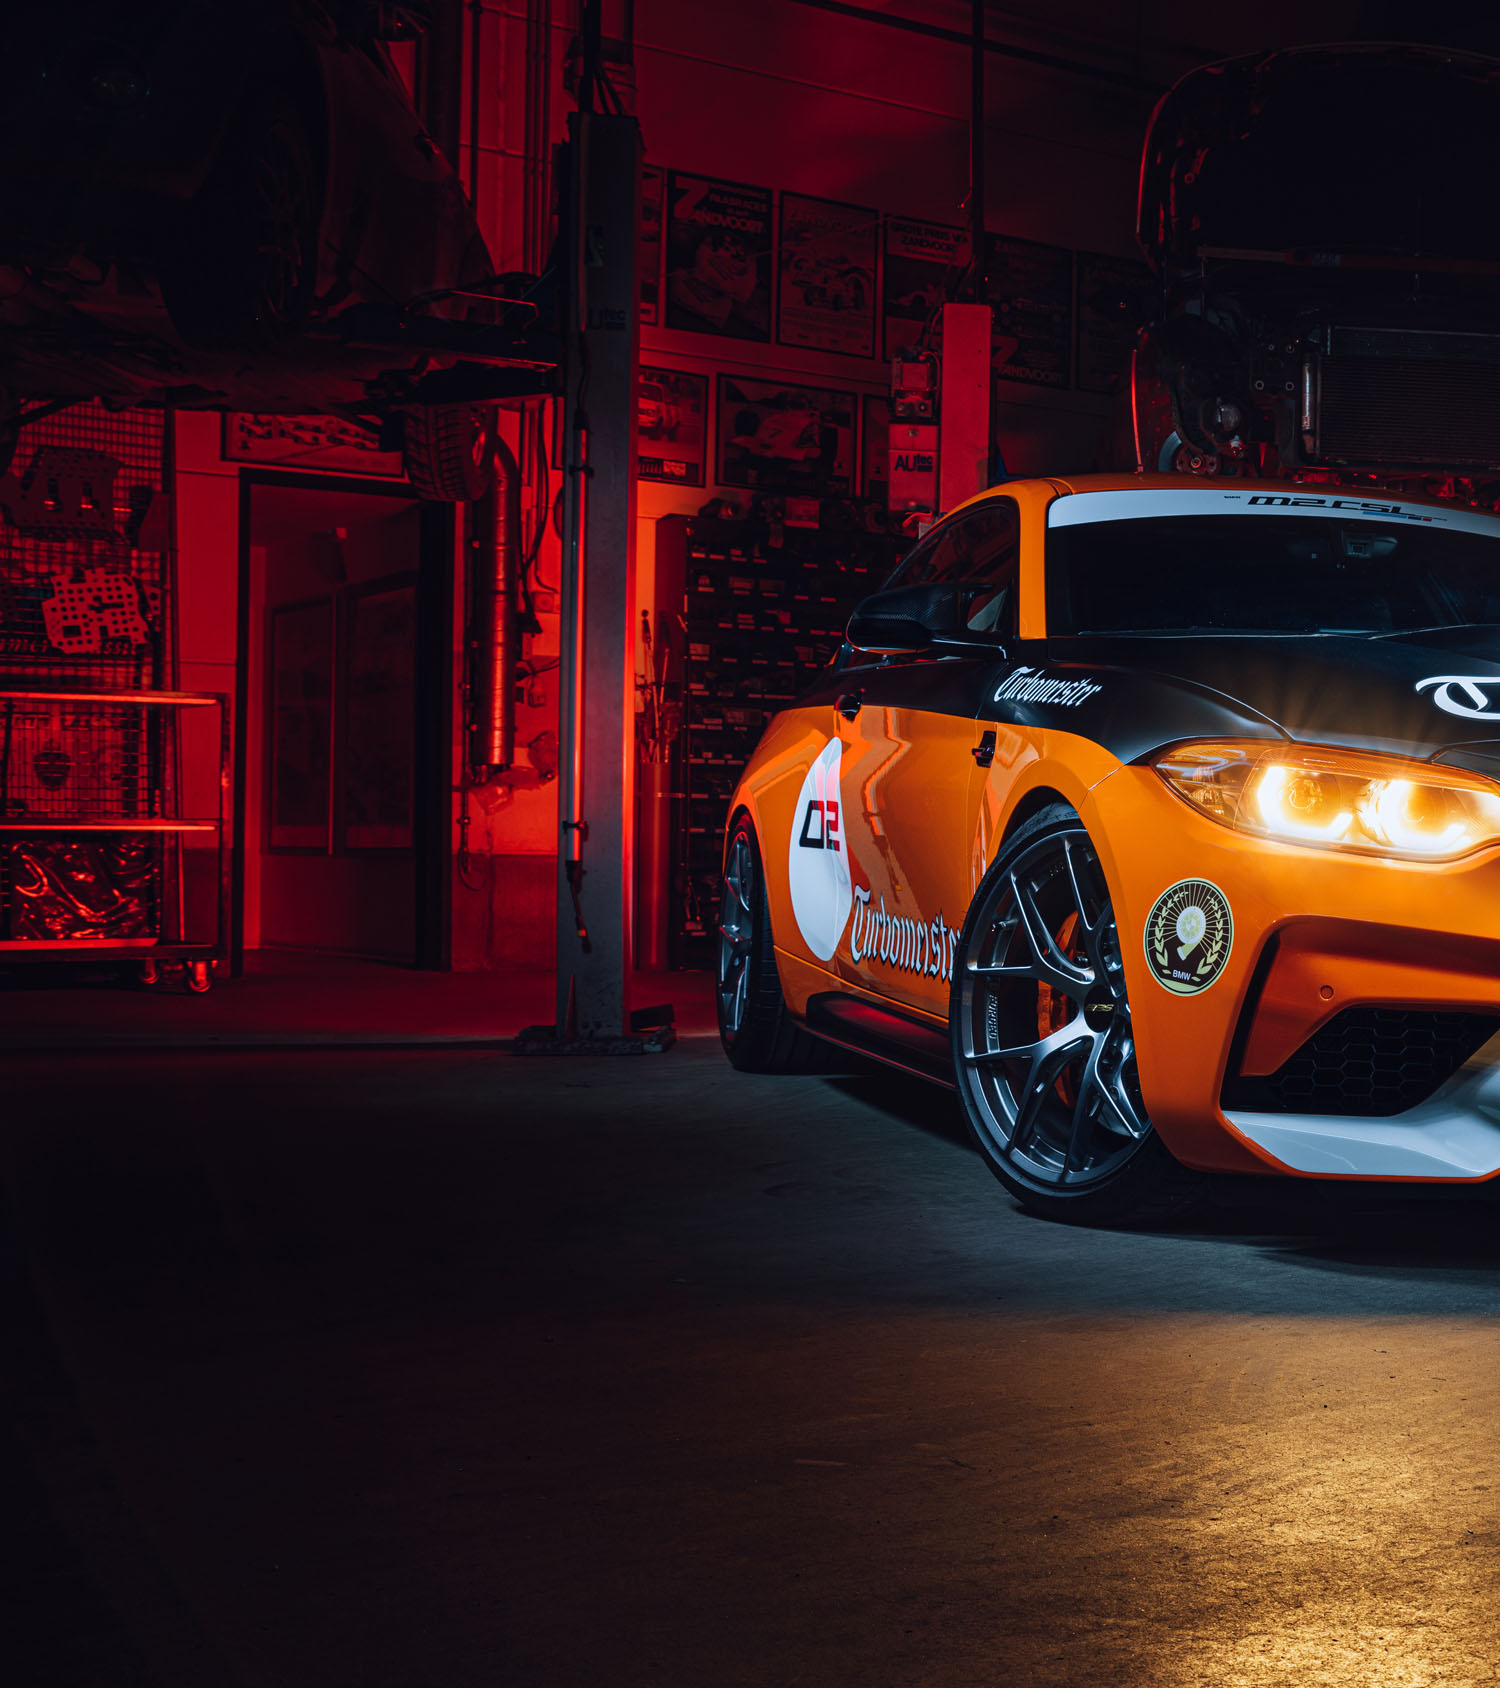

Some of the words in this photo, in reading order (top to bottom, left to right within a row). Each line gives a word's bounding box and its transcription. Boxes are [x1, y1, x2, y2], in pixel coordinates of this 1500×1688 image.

[994, 666, 1103, 707] Turbomeister
[851, 884, 961, 984] Turbomeiste
[1172, 969, 1192, 981] BMW
